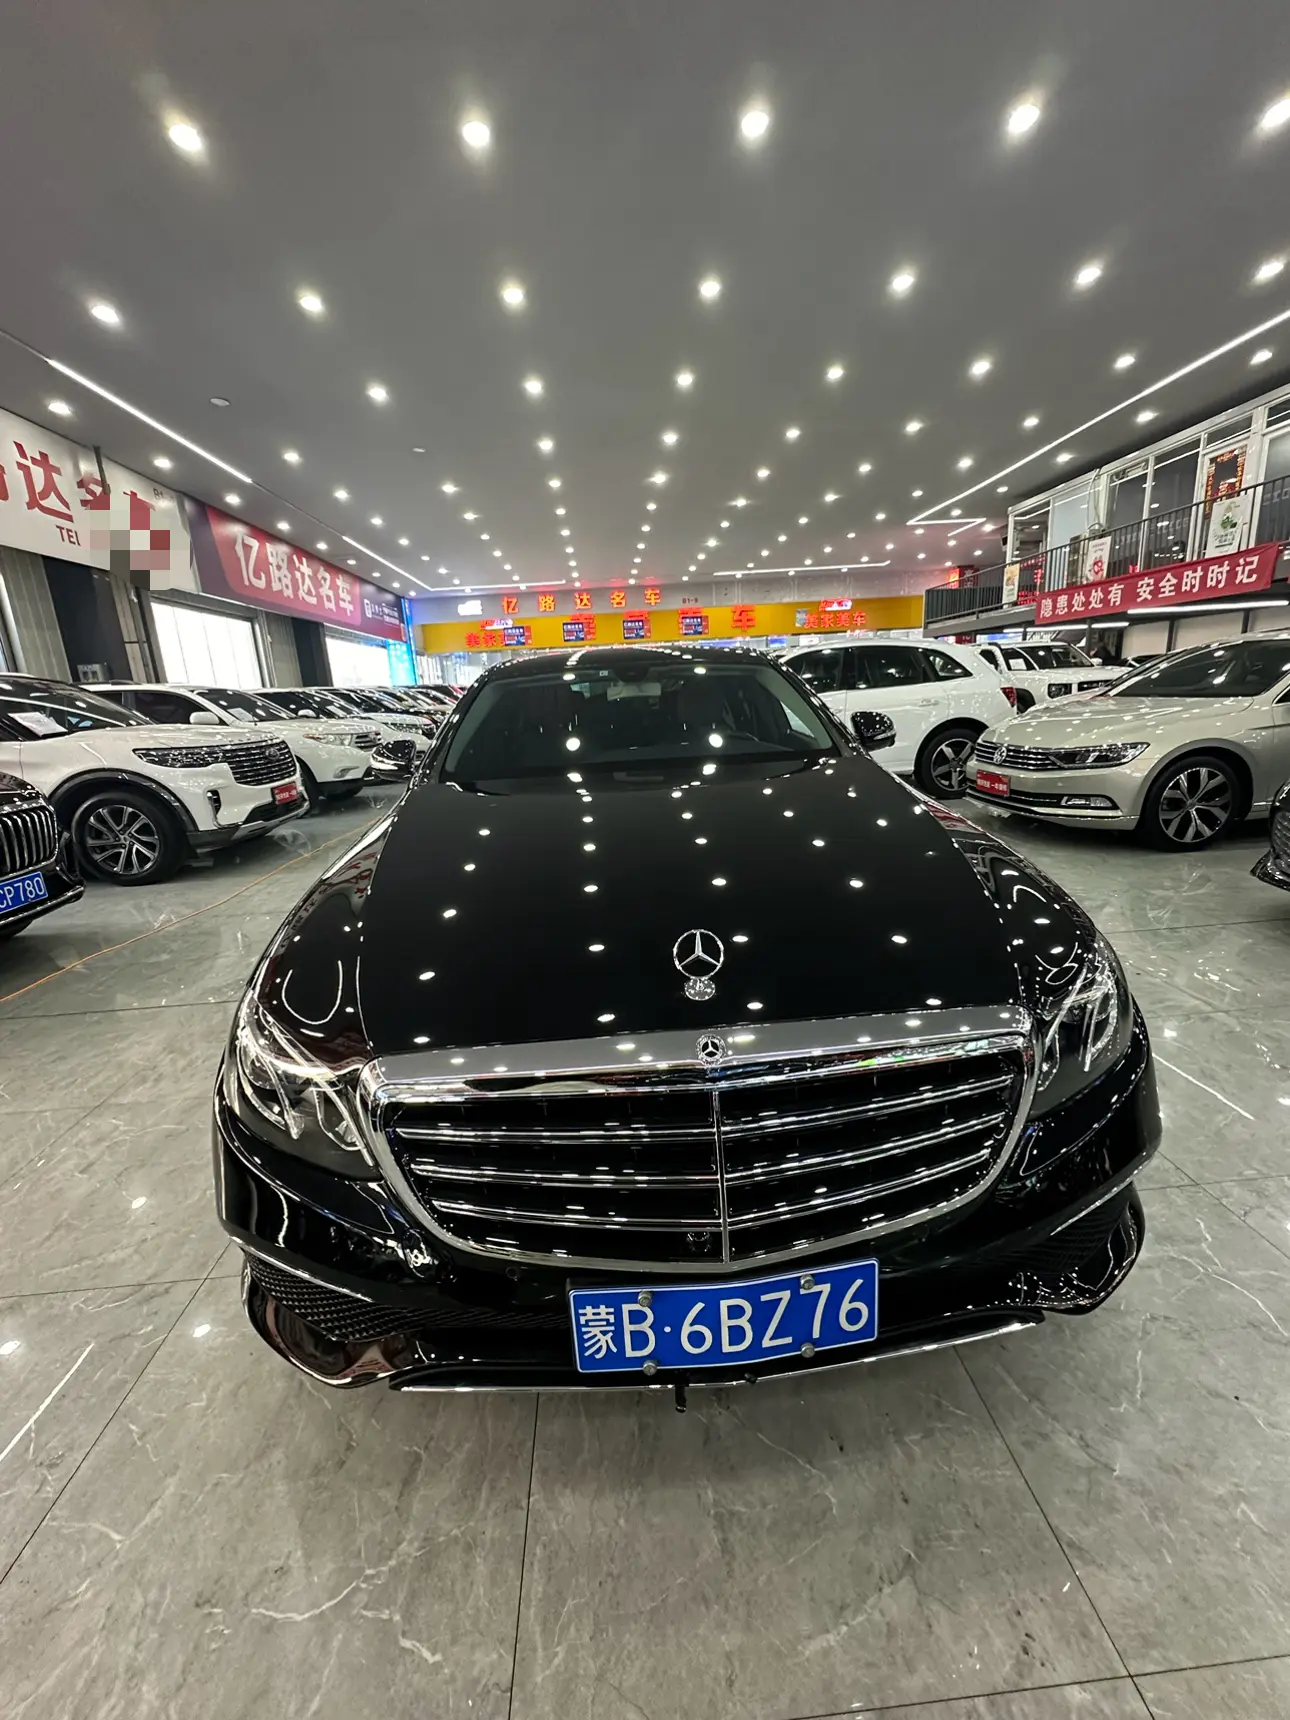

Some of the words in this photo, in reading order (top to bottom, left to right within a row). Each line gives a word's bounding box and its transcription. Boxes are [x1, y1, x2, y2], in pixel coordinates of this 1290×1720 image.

[234, 532, 355, 617] 亿路达名车
[502, 587, 662, 614] 亿路达名车
[1039, 583, 1125, 619] 隐患处处有
[1136, 555, 1260, 602] 安全时时记
[578, 1278, 869, 1360] 蒙B·6BZ76
